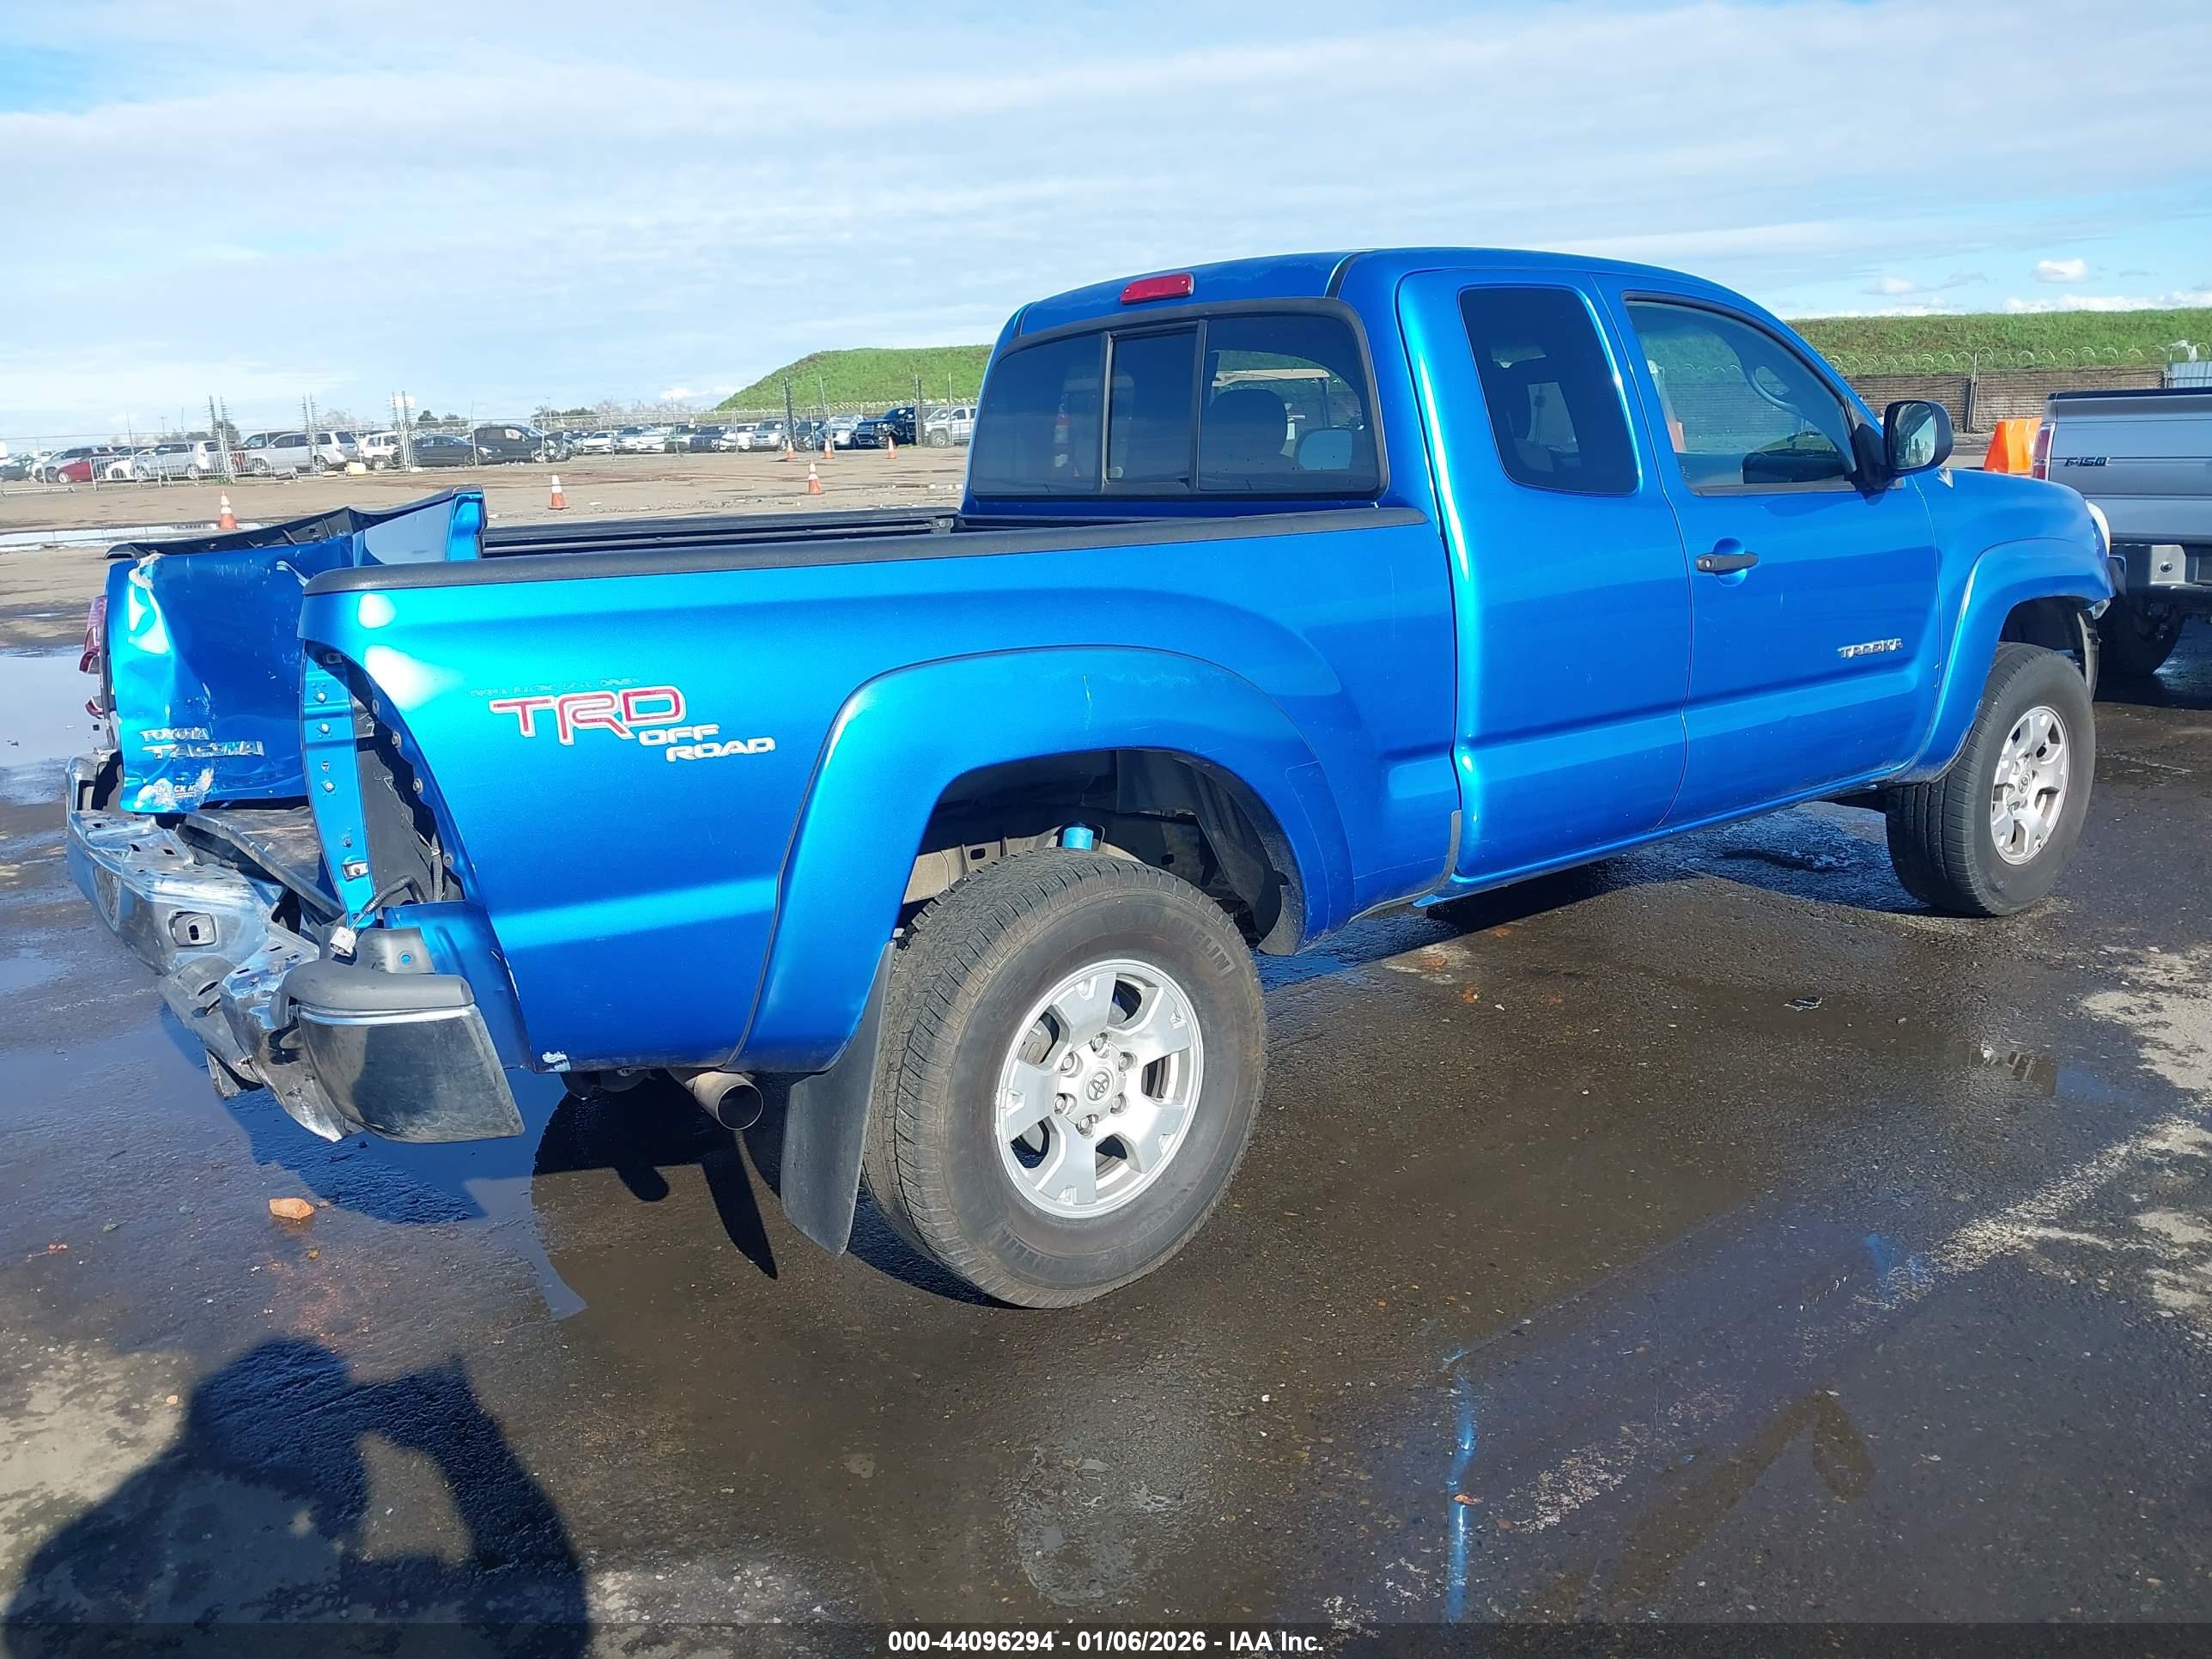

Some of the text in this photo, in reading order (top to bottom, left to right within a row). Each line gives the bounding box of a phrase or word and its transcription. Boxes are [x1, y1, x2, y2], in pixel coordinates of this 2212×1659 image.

[489, 685, 687, 745] TRD
[138, 727, 210, 743] TOYOTA
[638, 723, 720, 746] OFF
[142, 741, 265, 760] TACOMA
[665, 738, 776, 763] ROAD
